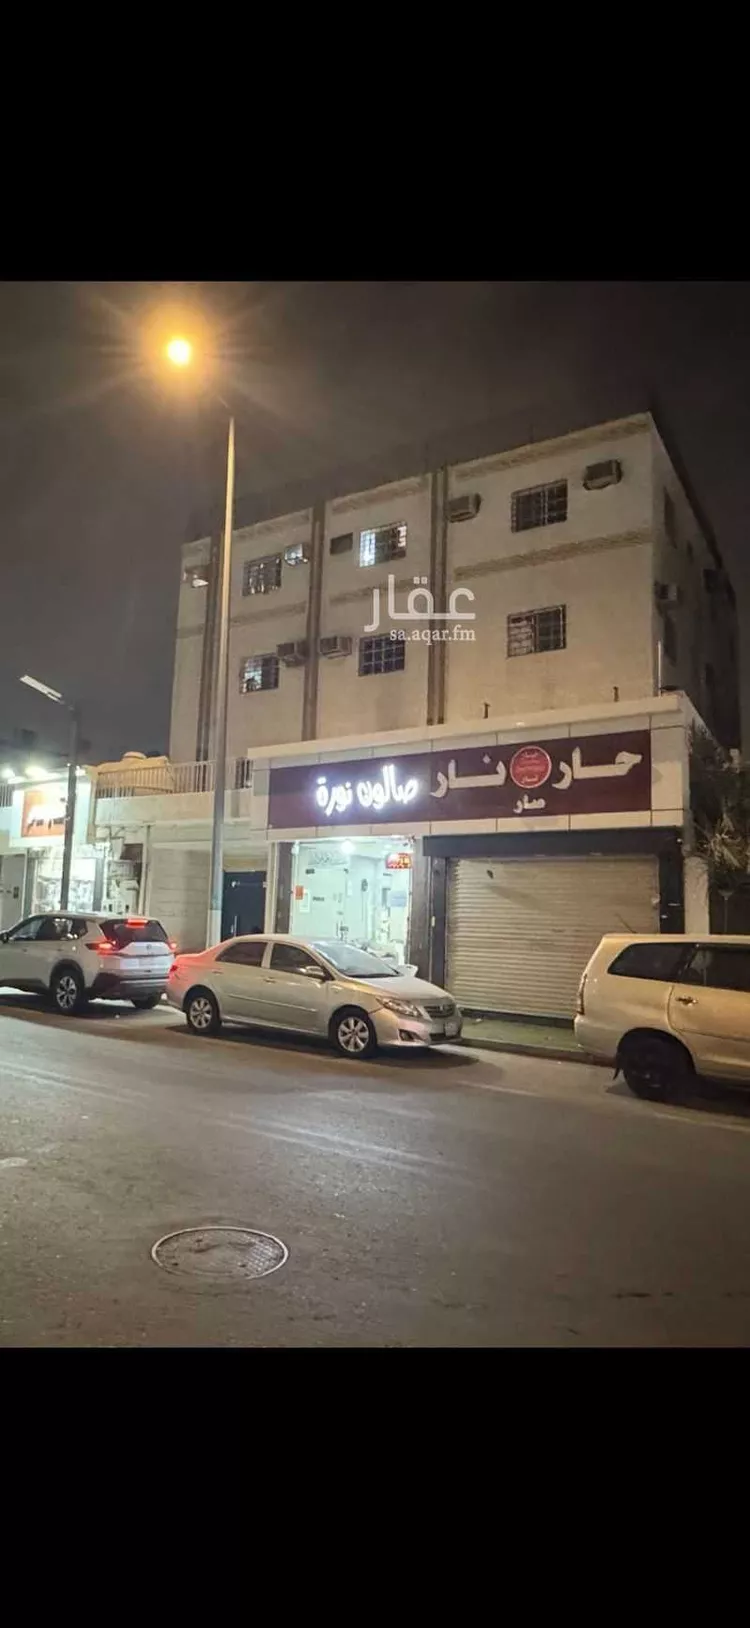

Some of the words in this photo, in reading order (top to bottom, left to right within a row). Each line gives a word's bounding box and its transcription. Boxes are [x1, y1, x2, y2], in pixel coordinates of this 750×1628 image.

[357, 763, 419, 810] صالون
[430, 754, 507, 798] نار
[552, 747, 643, 790] حار
[316, 776, 353, 816] نورة
